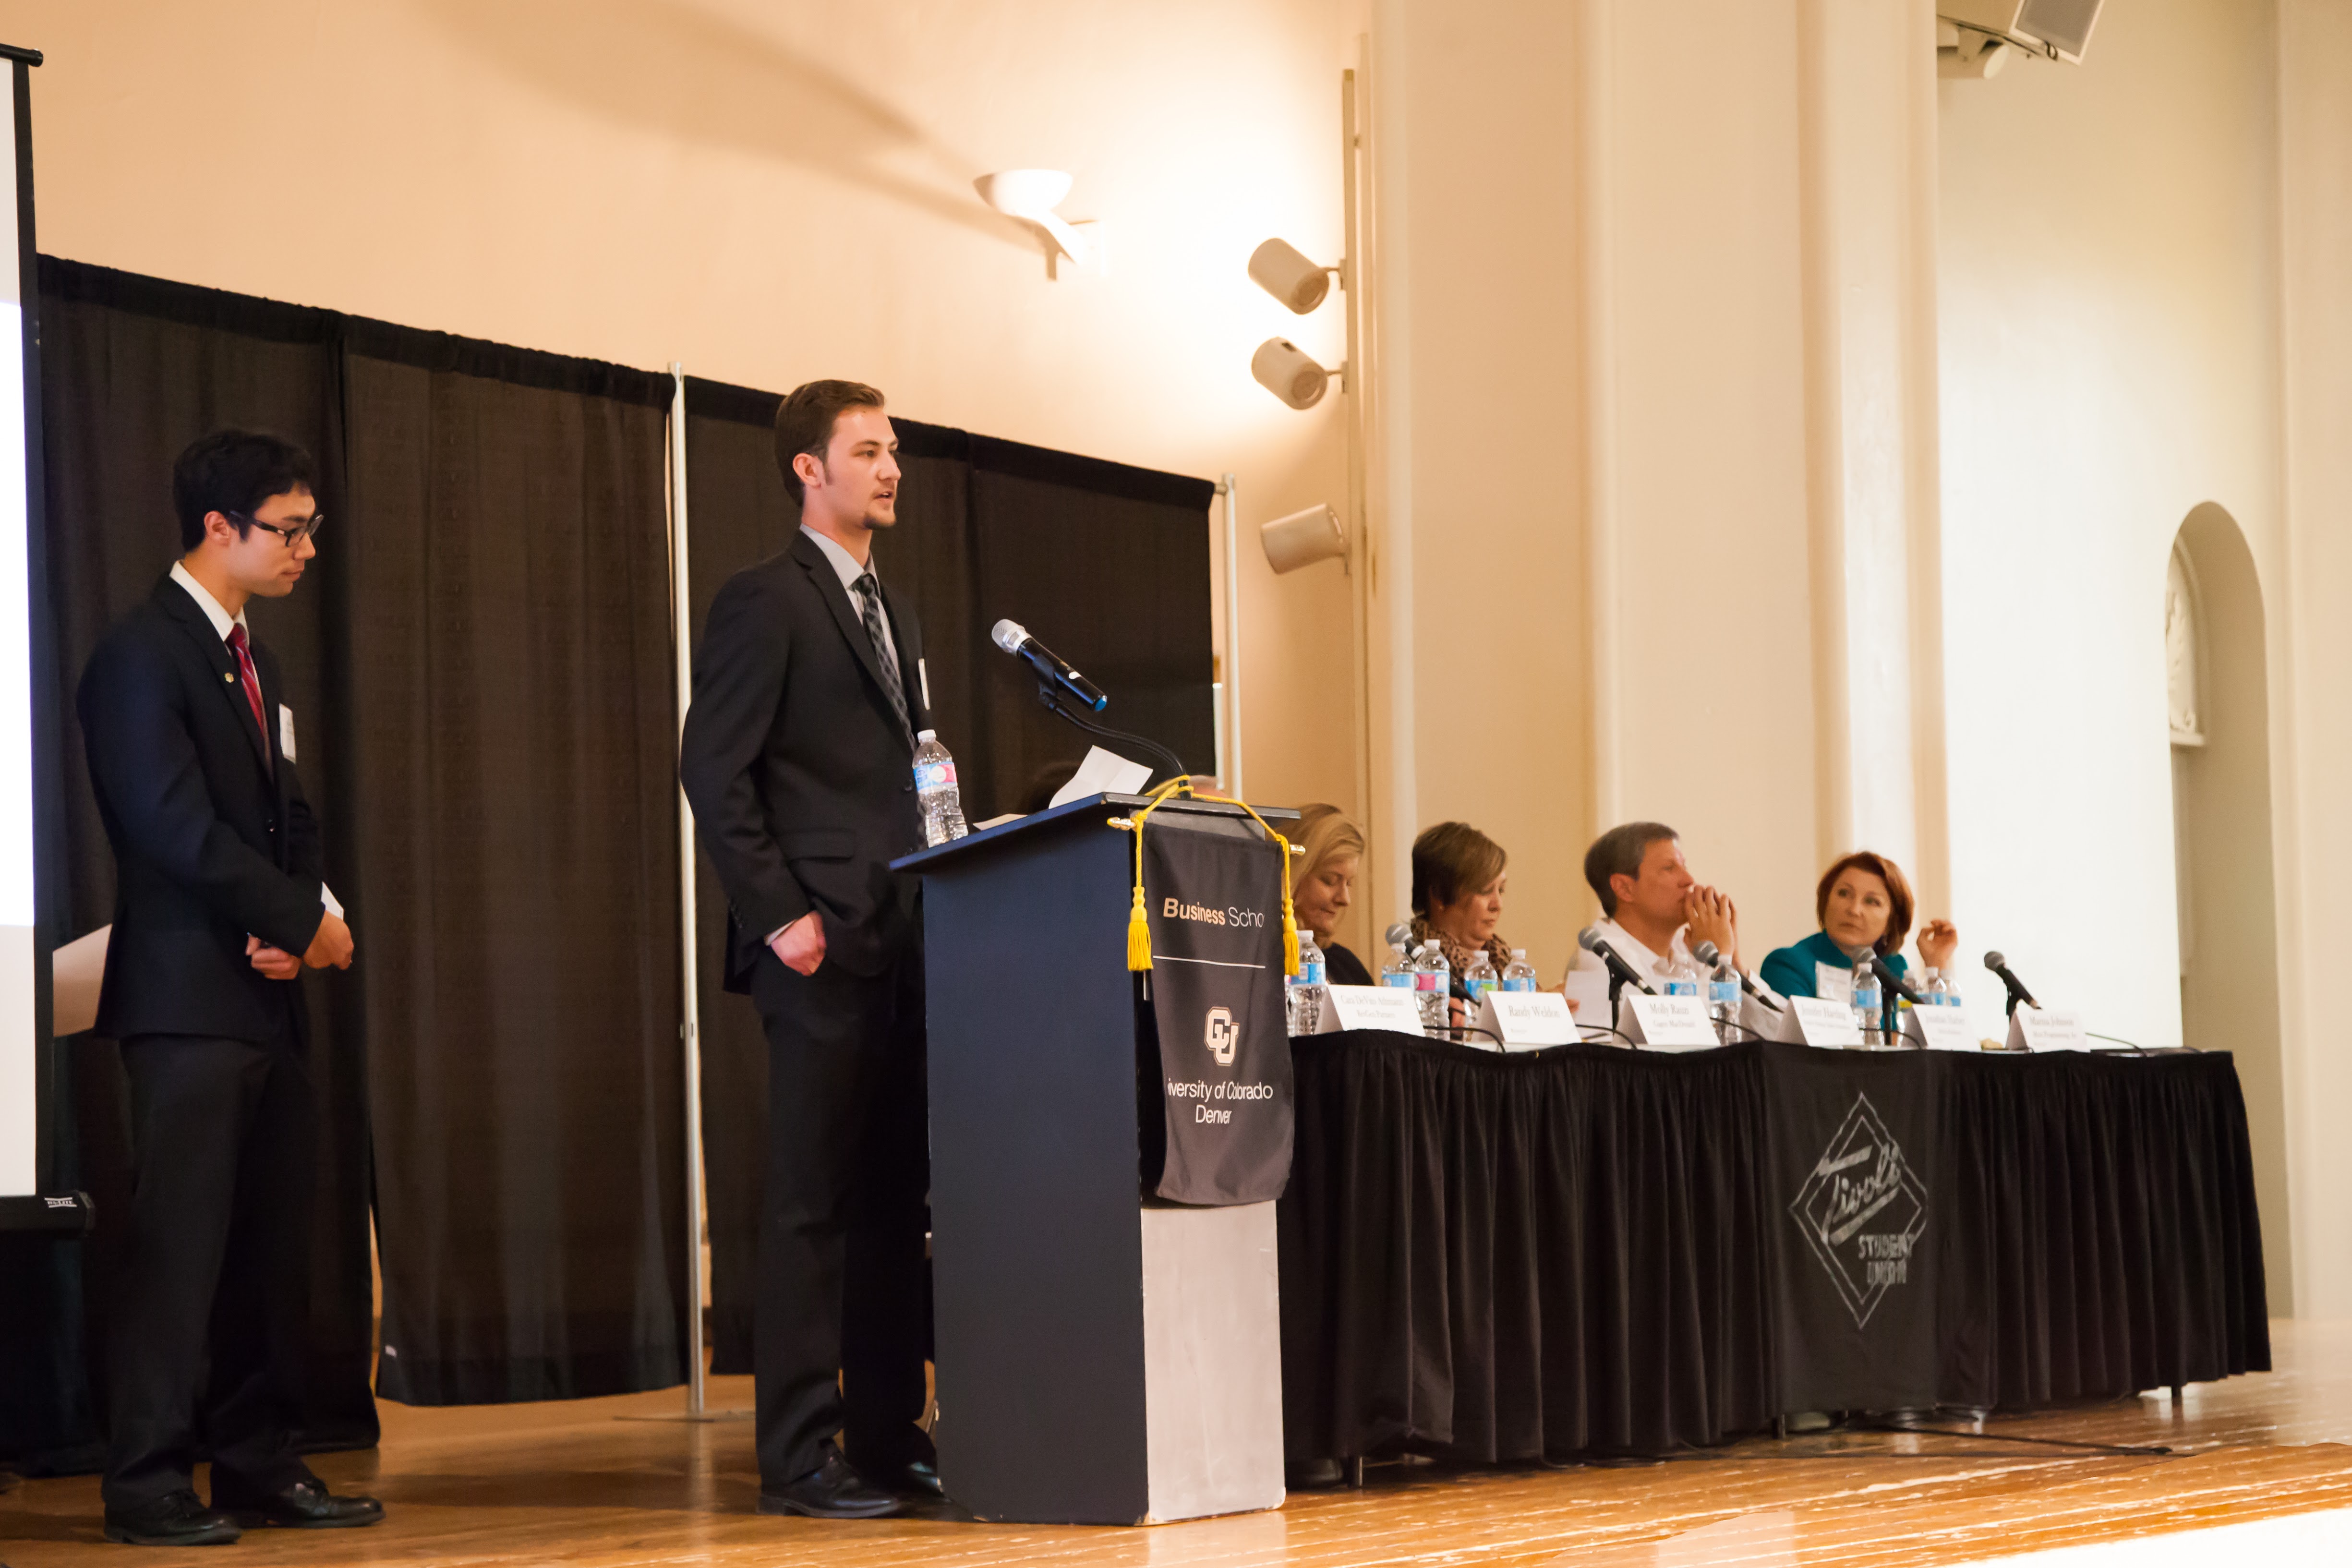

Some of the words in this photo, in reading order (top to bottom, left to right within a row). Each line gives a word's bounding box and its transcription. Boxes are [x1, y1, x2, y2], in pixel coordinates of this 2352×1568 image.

[1163, 897, 1226, 926] Business
[1228, 906, 1265, 928] Scho
[1508, 1005, 1530, 1020] Randy
[1531, 1006, 1560, 1019] Weldon
[1650, 1002, 1669, 1017] Molly
[1204, 1006, 1240, 1066] CU
[1168, 1078, 1212, 1102] iversity
[1214, 1081, 1226, 1099] of
[1227, 1081, 1273, 1100] Colorado
[1195, 1104, 1232, 1124] Denver
[1857, 1233, 1915, 1259] STUDENT
[1867, 1259, 1907, 1285] UNION
